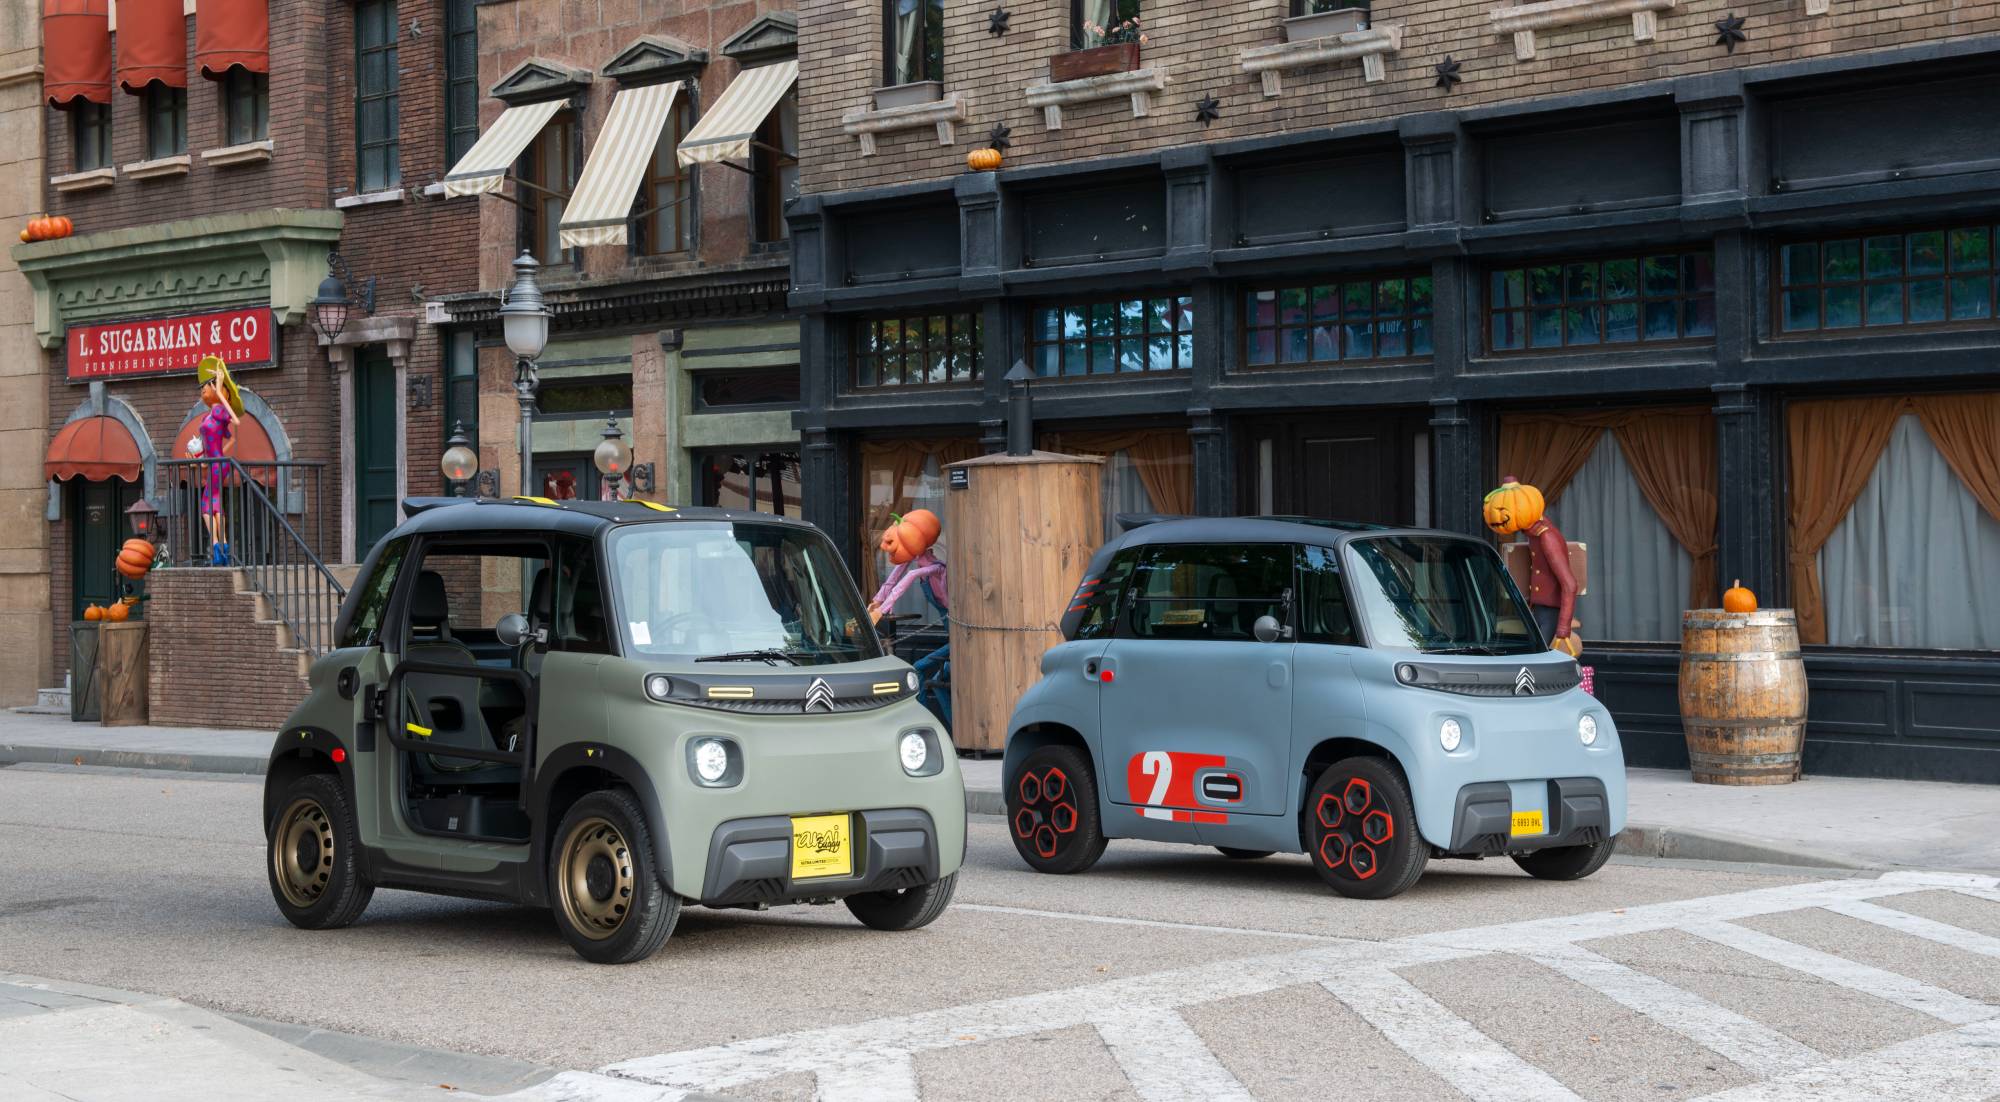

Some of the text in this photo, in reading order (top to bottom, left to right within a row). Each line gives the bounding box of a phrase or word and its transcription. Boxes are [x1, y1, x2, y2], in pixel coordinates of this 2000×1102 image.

[79, 316, 258, 357] L. SUGARMAN & CO
[85, 356, 173, 373] FURNISHINGS
[1143, 751, 1173, 821] 2
